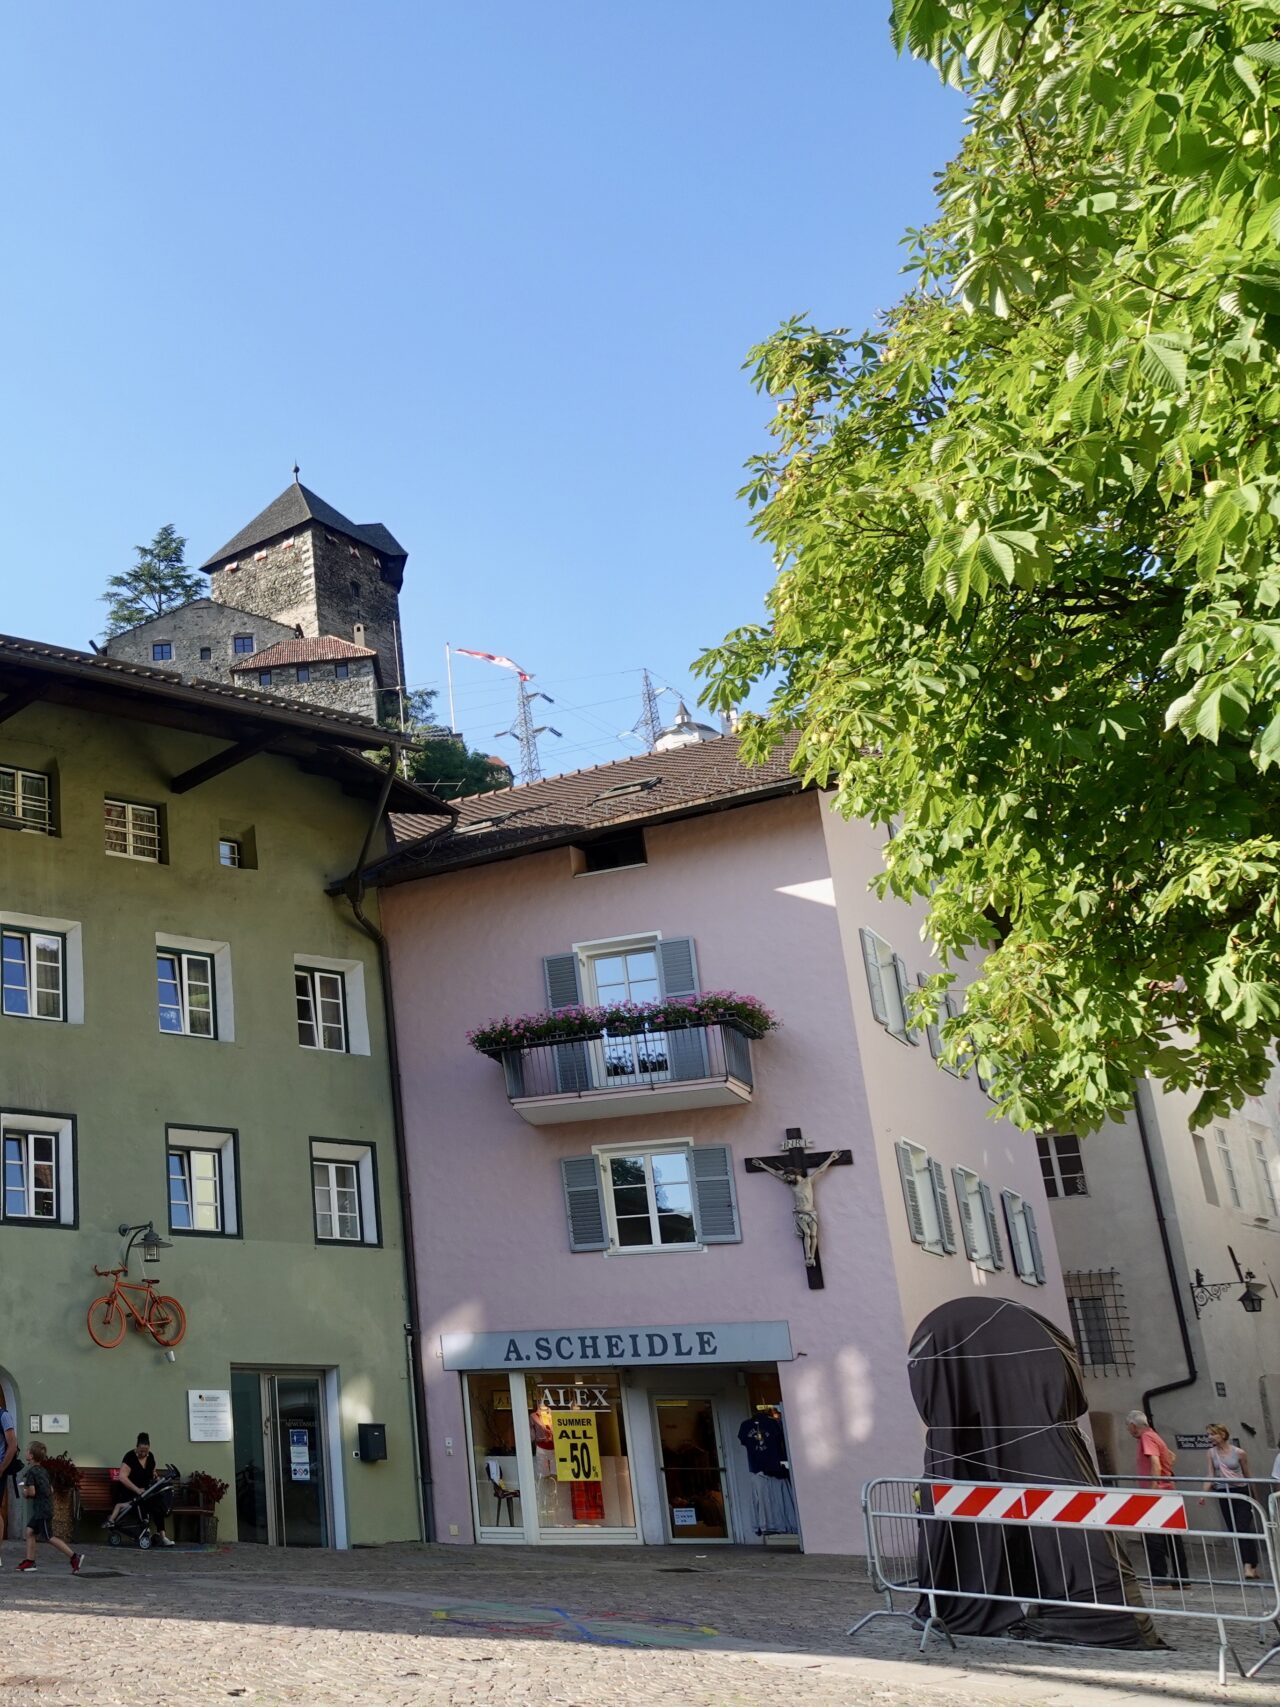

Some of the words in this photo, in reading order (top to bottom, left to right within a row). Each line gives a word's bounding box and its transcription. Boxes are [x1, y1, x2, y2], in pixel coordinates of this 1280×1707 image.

[783, 1138, 807, 1149] INRI
[541, 1387, 610, 1407] ALEX
[557, 1418, 592, 1427] SUMMER
[558, 1429, 594, 1440] ALL
